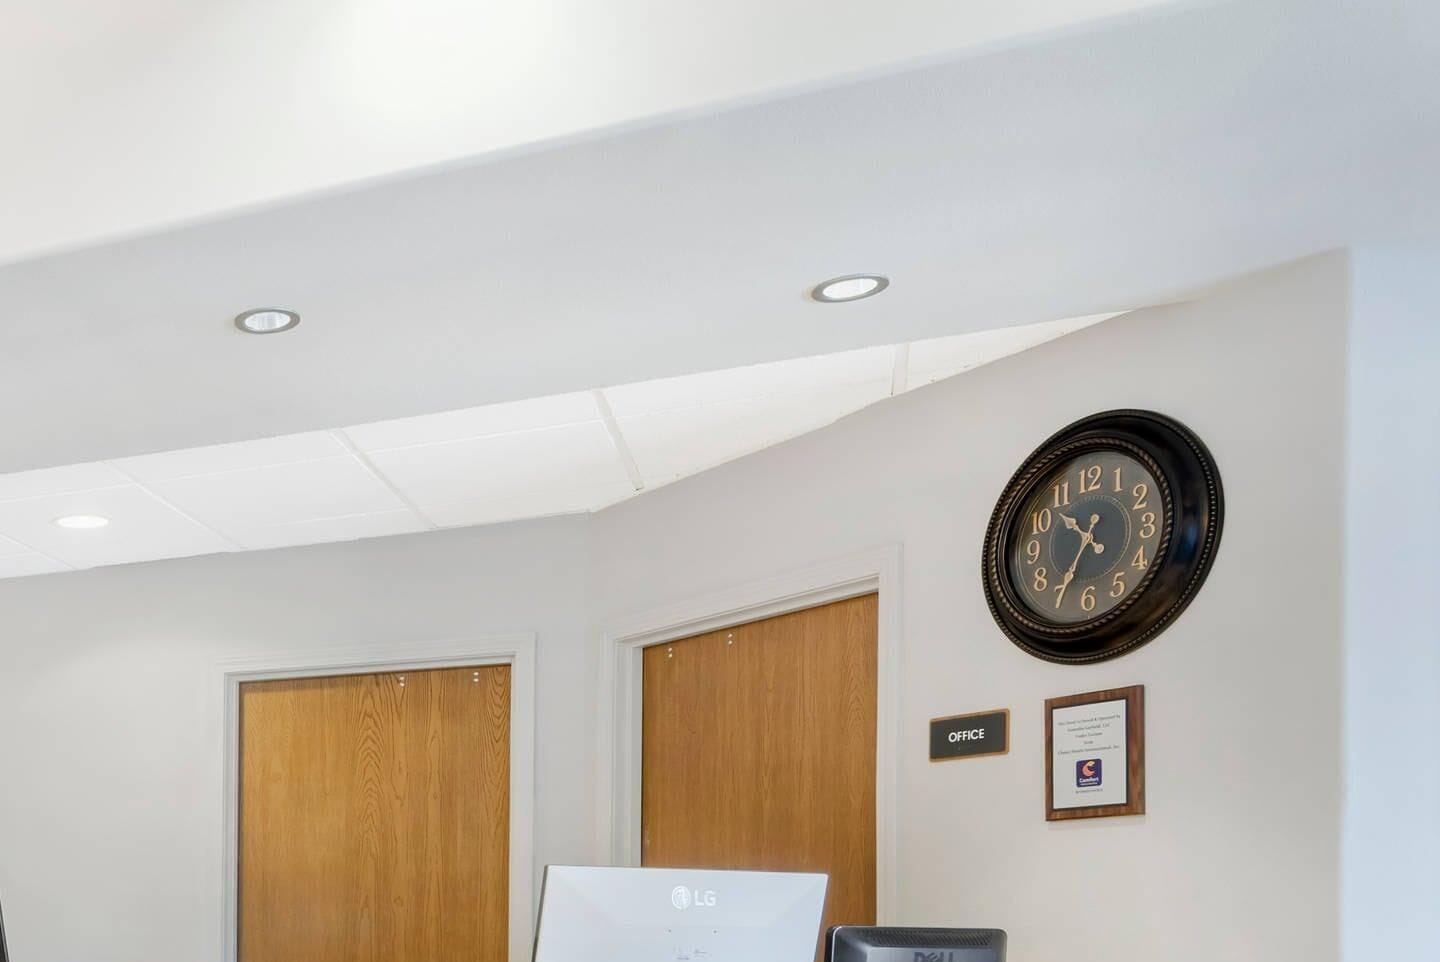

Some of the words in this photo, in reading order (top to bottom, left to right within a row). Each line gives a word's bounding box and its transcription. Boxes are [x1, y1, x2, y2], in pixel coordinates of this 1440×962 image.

[1078, 465, 1102, 494] 12
[1113, 467, 1123, 492] 1
[1052, 481, 1071, 508] 11
[1132, 483, 1148, 510] 2
[1031, 508, 1052, 535] 10
[1139, 512, 1156, 539] 3
[1026, 539, 1041, 565] 9
[1131, 545, 1148, 570] 4
[1033, 567, 1048, 592] 8
[1110, 571, 1126, 598] 5
[1053, 584, 1067, 609] 7
[1080, 585, 1096, 611] 6
[948, 728, 985, 743] OFFICE
[694, 889, 717, 906] LG
